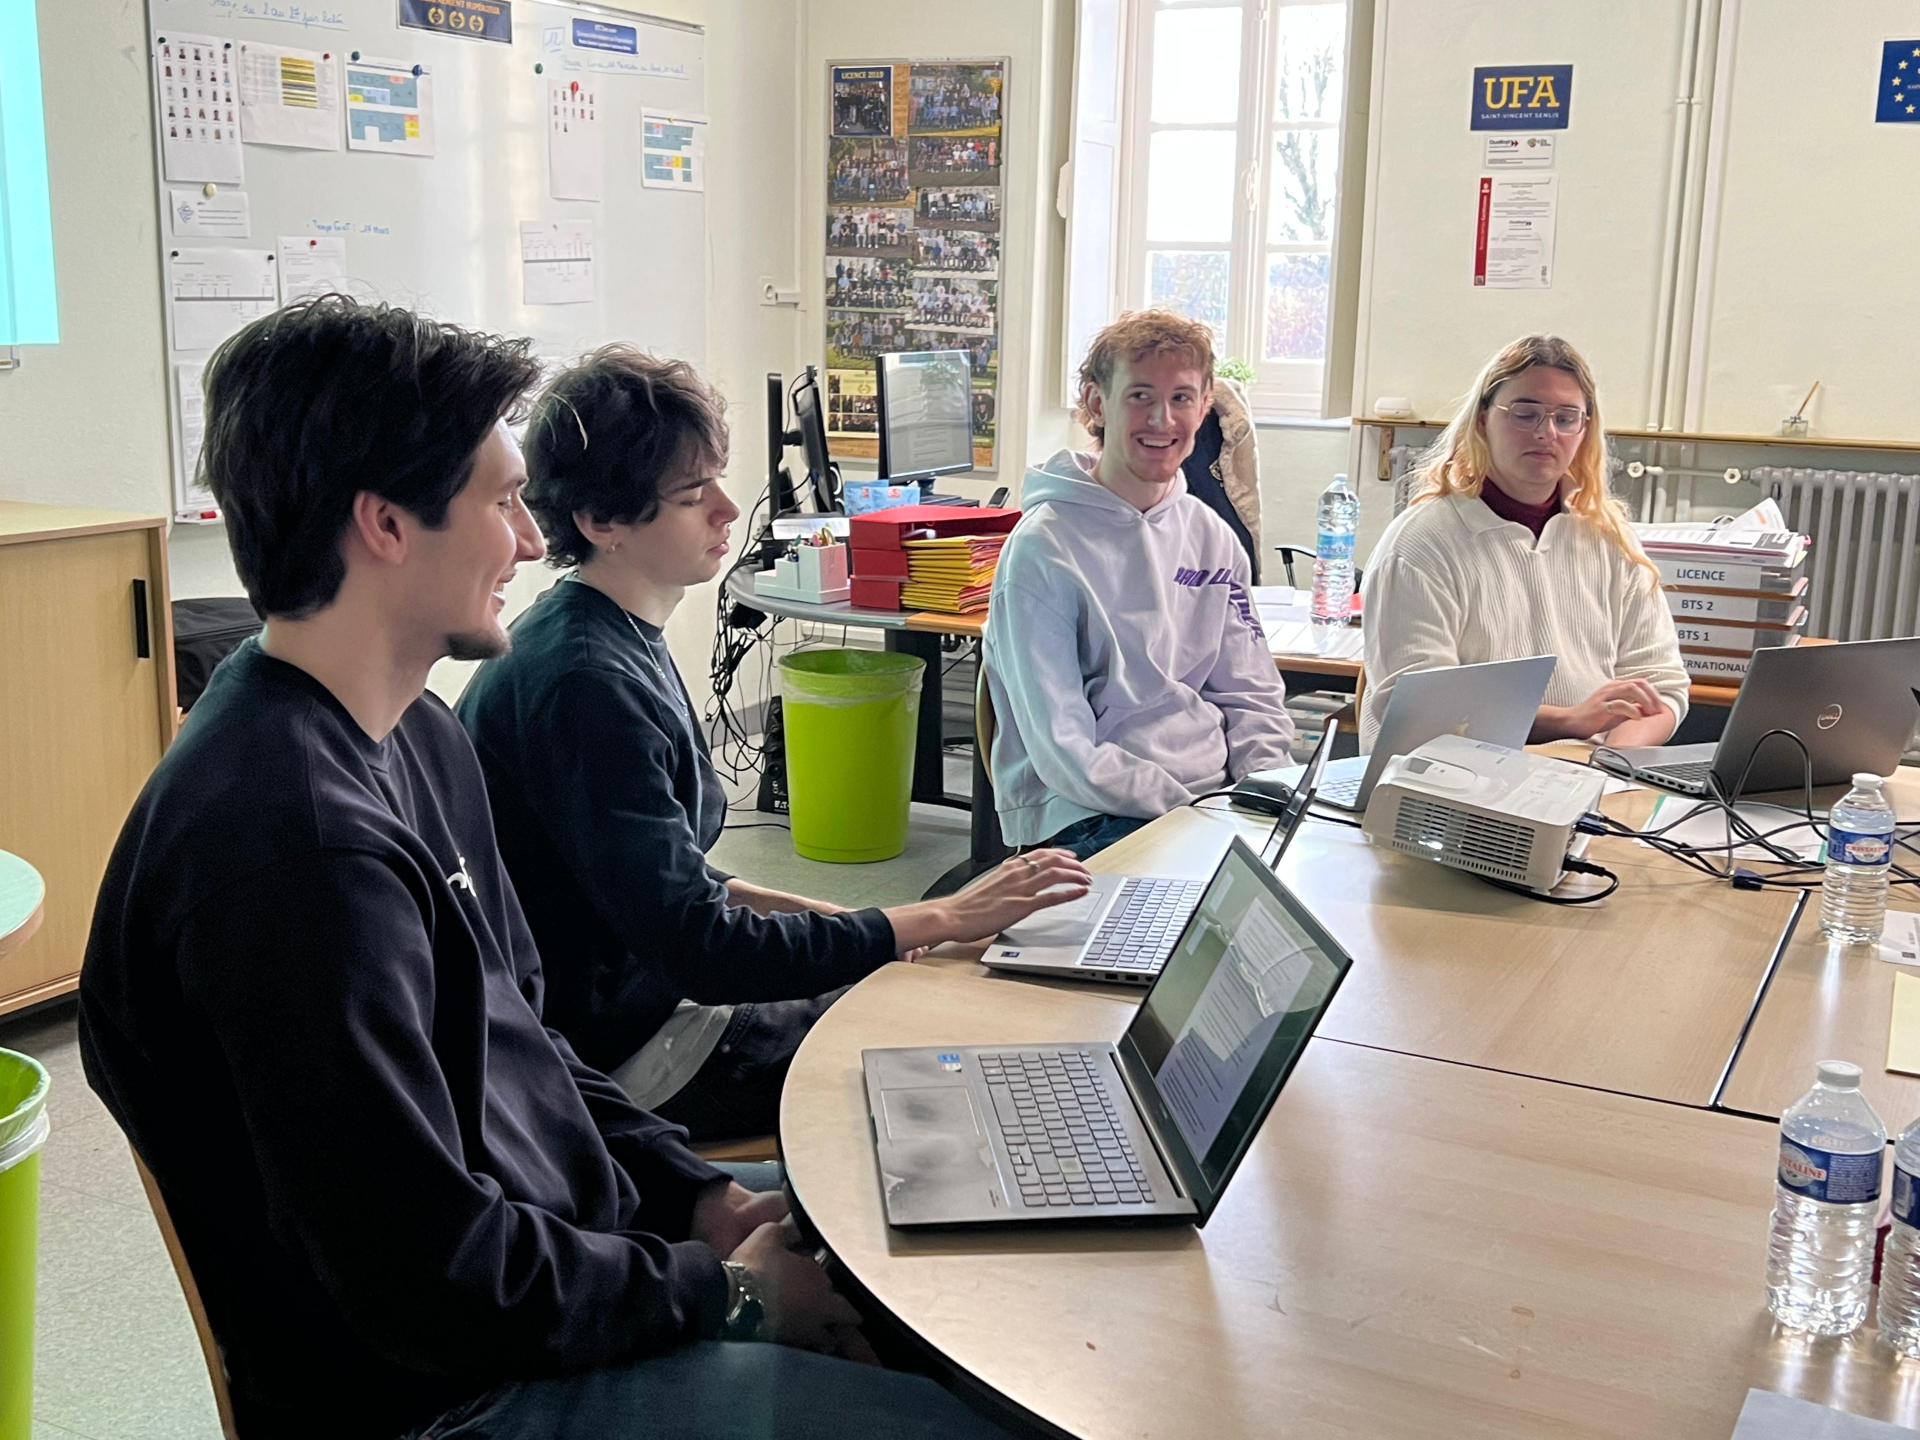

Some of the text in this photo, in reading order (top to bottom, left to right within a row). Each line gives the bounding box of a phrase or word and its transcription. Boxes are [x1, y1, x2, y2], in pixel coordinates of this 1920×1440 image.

[1484, 76, 1560, 109] UFA
[1481, 112, 1533, 120] SAINT-VINCENT
[1676, 569, 1725, 581] LICENCE
[1681, 599, 1714, 611] BTS 2
[1678, 630, 1710, 641] BTS 1
